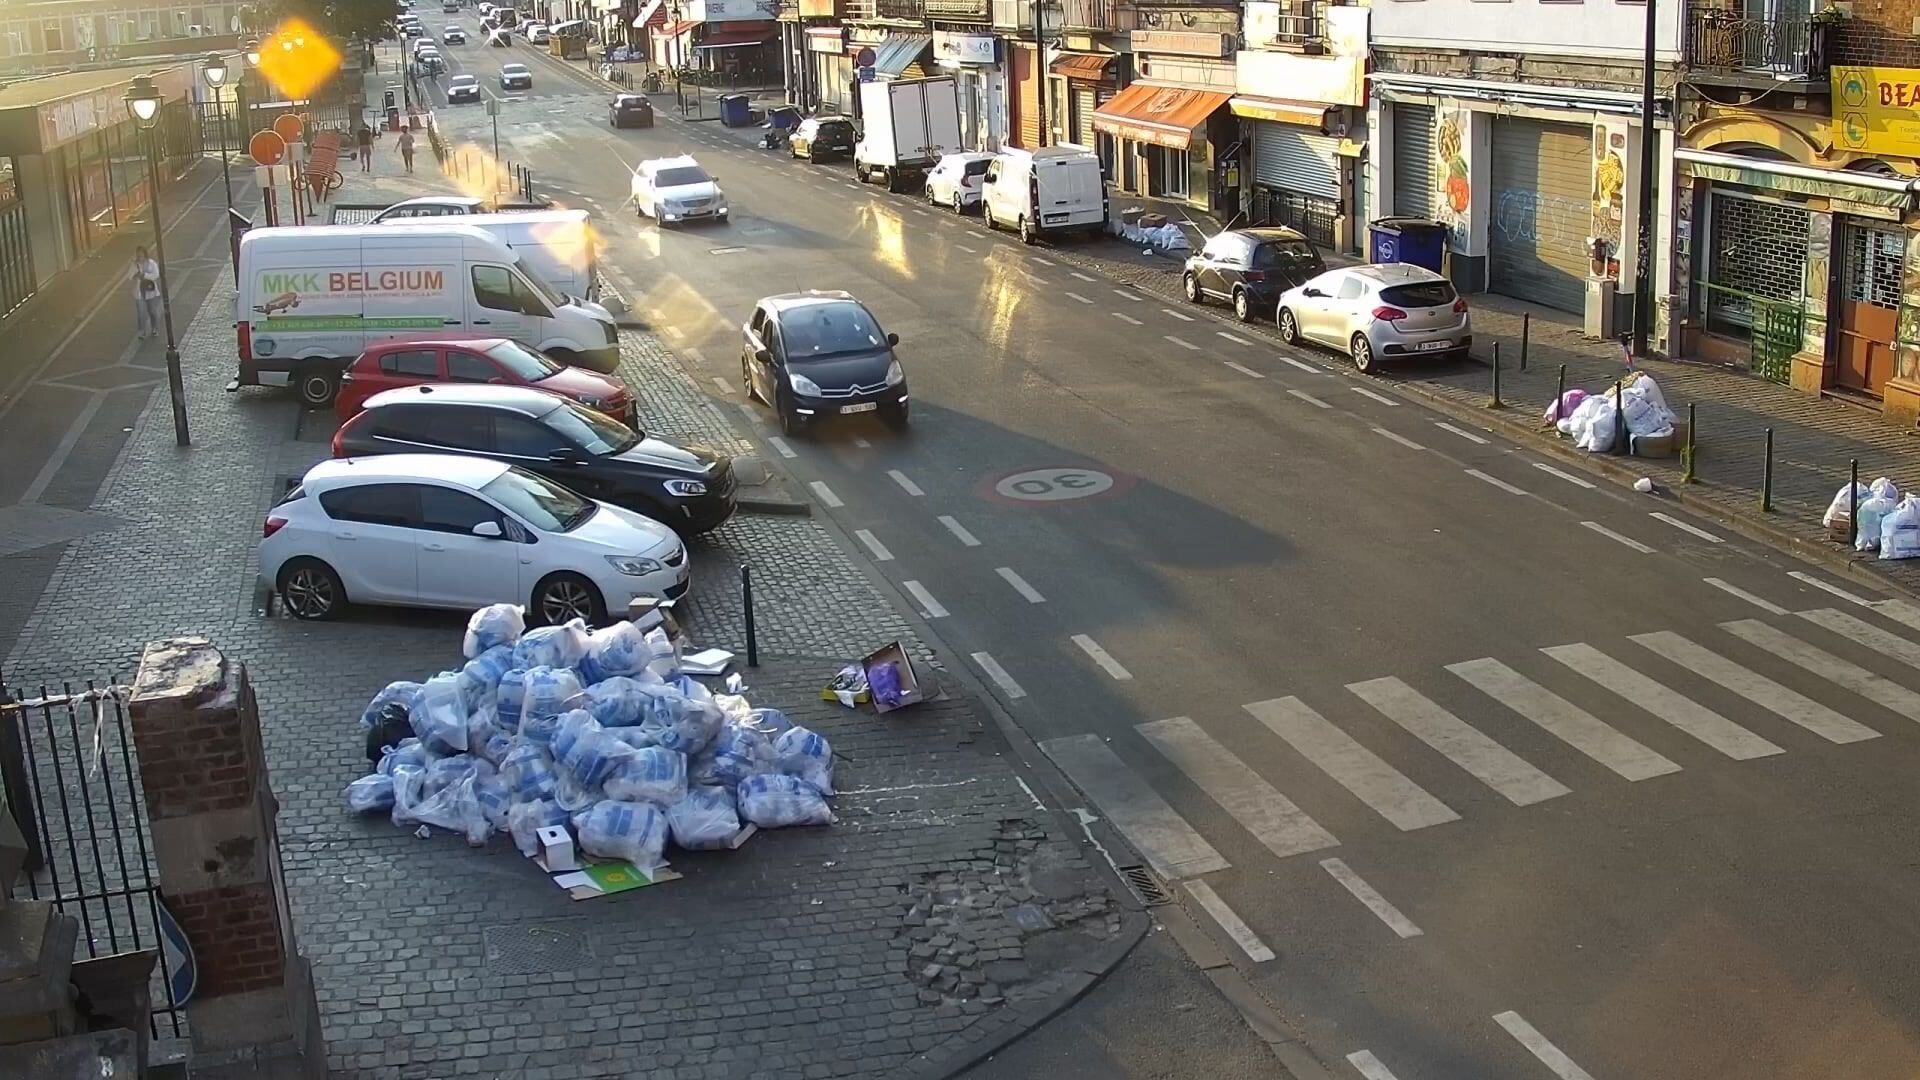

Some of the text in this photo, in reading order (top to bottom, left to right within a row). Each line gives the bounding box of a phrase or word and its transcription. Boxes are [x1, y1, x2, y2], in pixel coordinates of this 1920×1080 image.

[263, 271, 443, 294] MKK BELGIUM
[1012, 474, 1096, 494] 30
